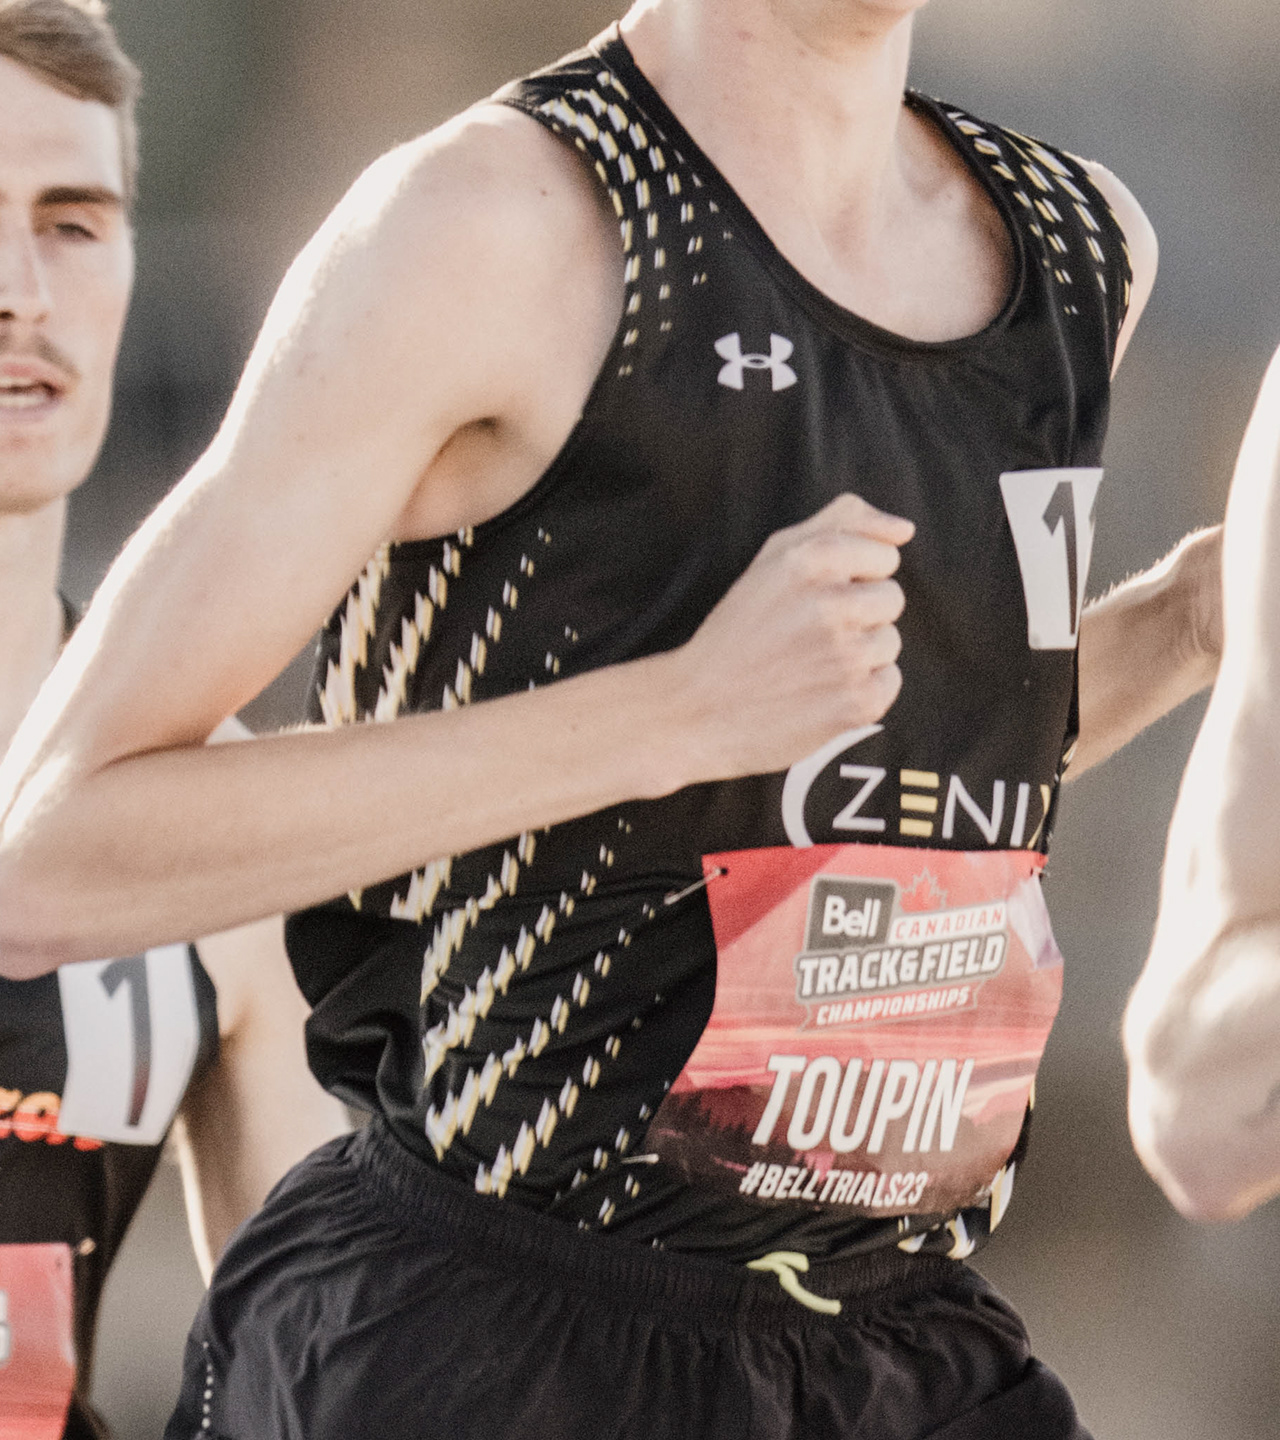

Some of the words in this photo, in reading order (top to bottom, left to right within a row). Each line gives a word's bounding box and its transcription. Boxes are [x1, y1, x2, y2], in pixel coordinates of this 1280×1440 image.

[823, 894, 881, 938] Bell
[895, 908, 1003, 940] CANADIAN
[798, 937, 1006, 997] TRACK&FIELD
[816, 986, 970, 1026] CHAMPIONSHIPS
[98, 955, 152, 1128] 1
[752, 1054, 975, 1155] TOUPIN
[740, 1162, 928, 1208] #BELLTRIALS23
